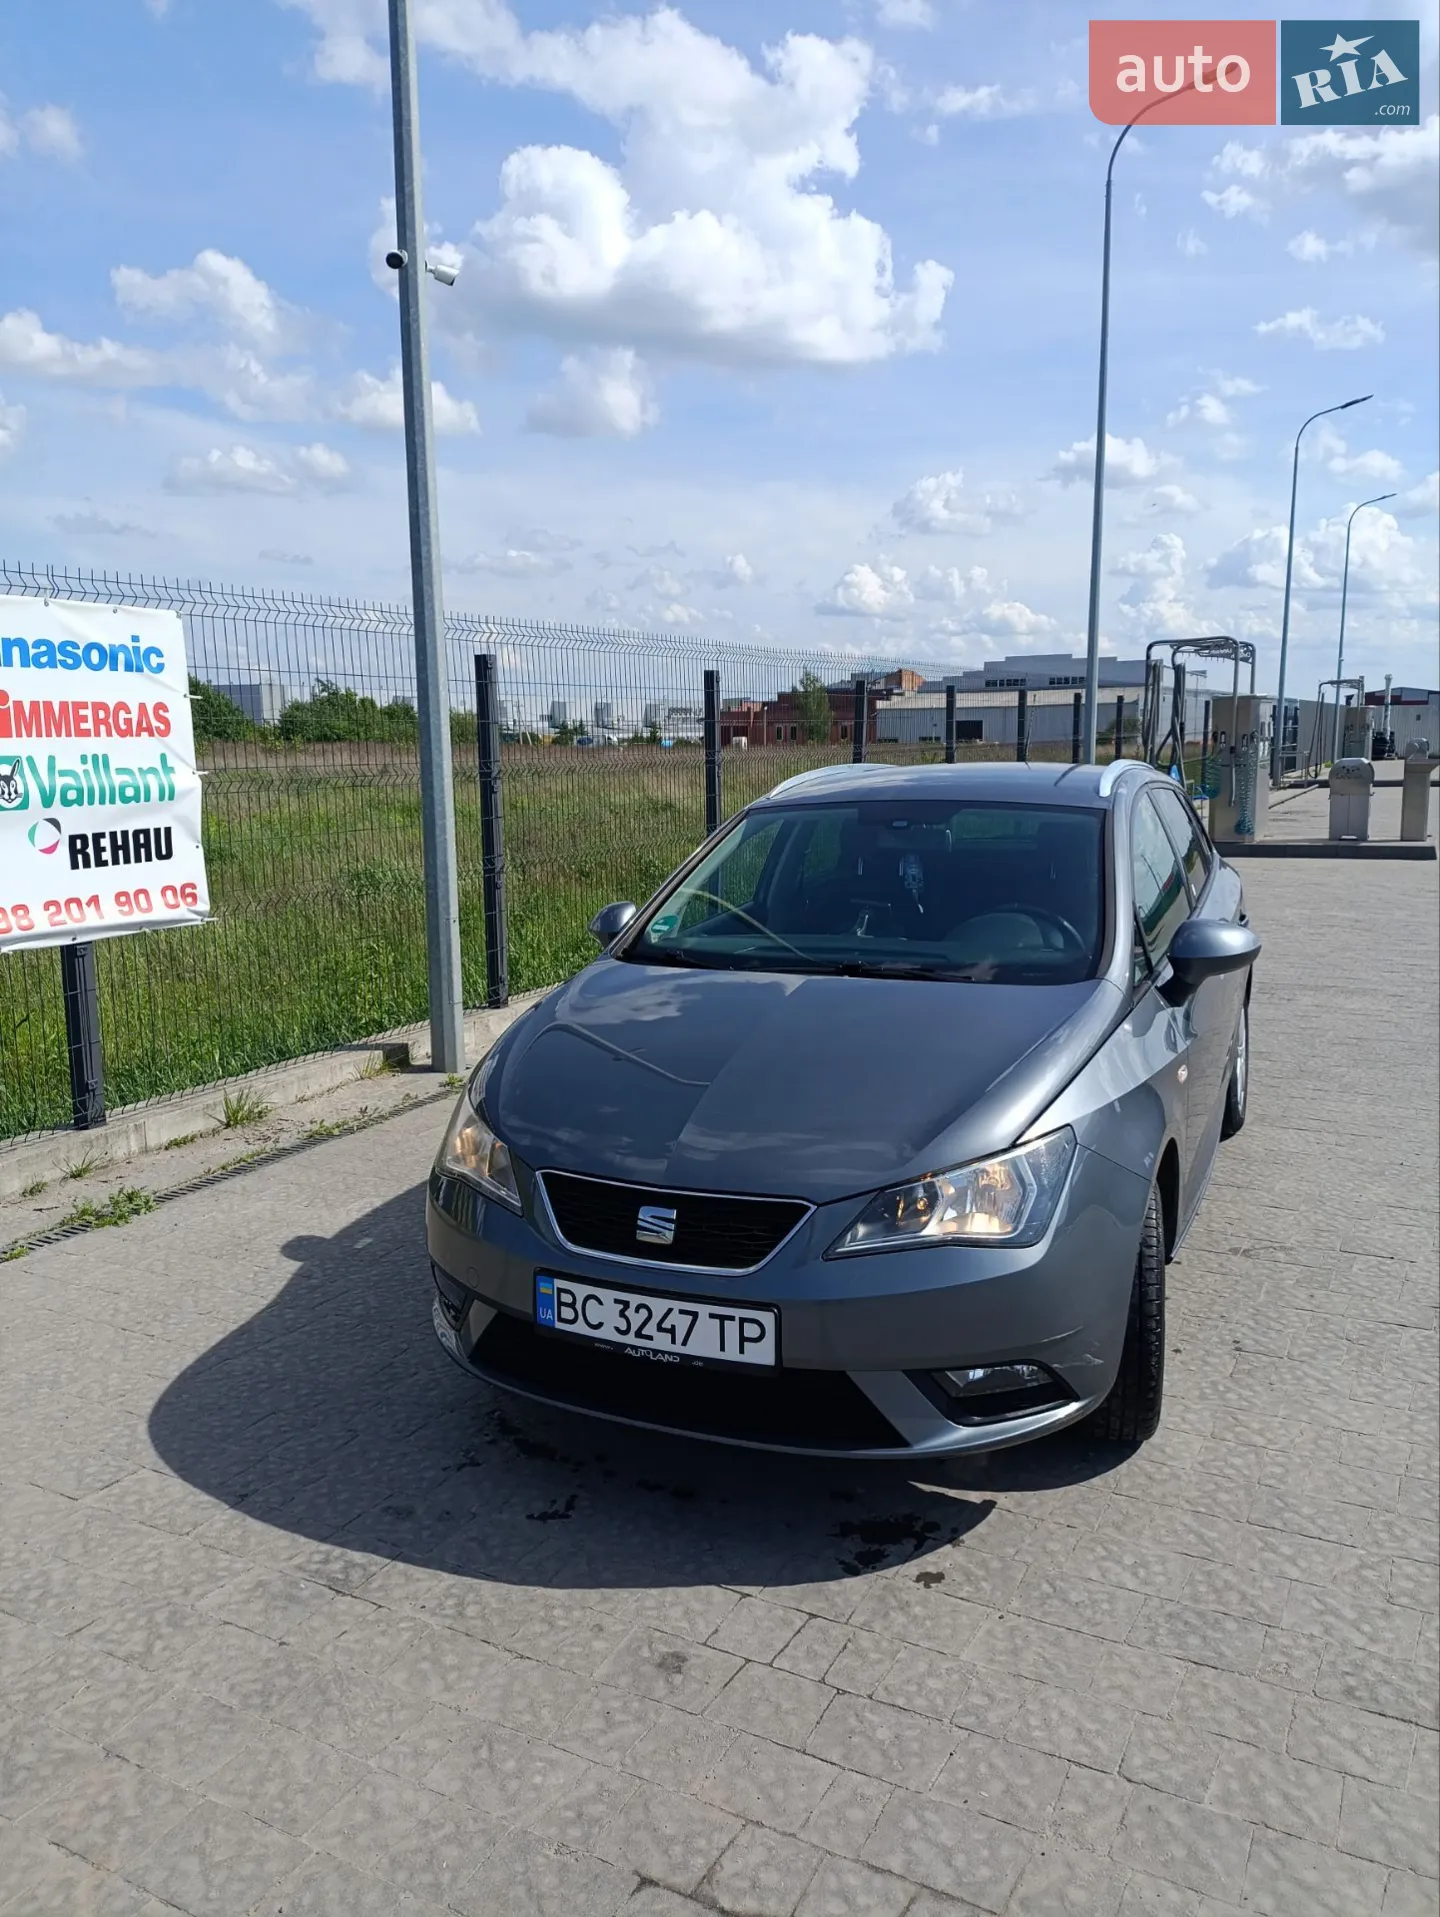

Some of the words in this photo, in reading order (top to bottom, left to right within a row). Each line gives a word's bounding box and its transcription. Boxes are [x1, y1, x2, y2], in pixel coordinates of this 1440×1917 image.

[0, 635, 165, 674] nasonic
[26, 753, 176, 809] Vaillant
[68, 827, 173, 870] REHAU
[43, 895, 105, 927] 201
[114, 887, 153, 916] 90
[160, 883, 198, 910] 06
[539, 1309, 554, 1321] UA
[556, 1287, 605, 1331] BC
[613, 1299, 699, 1347] 3247
[708, 1313, 766, 1355] TP
